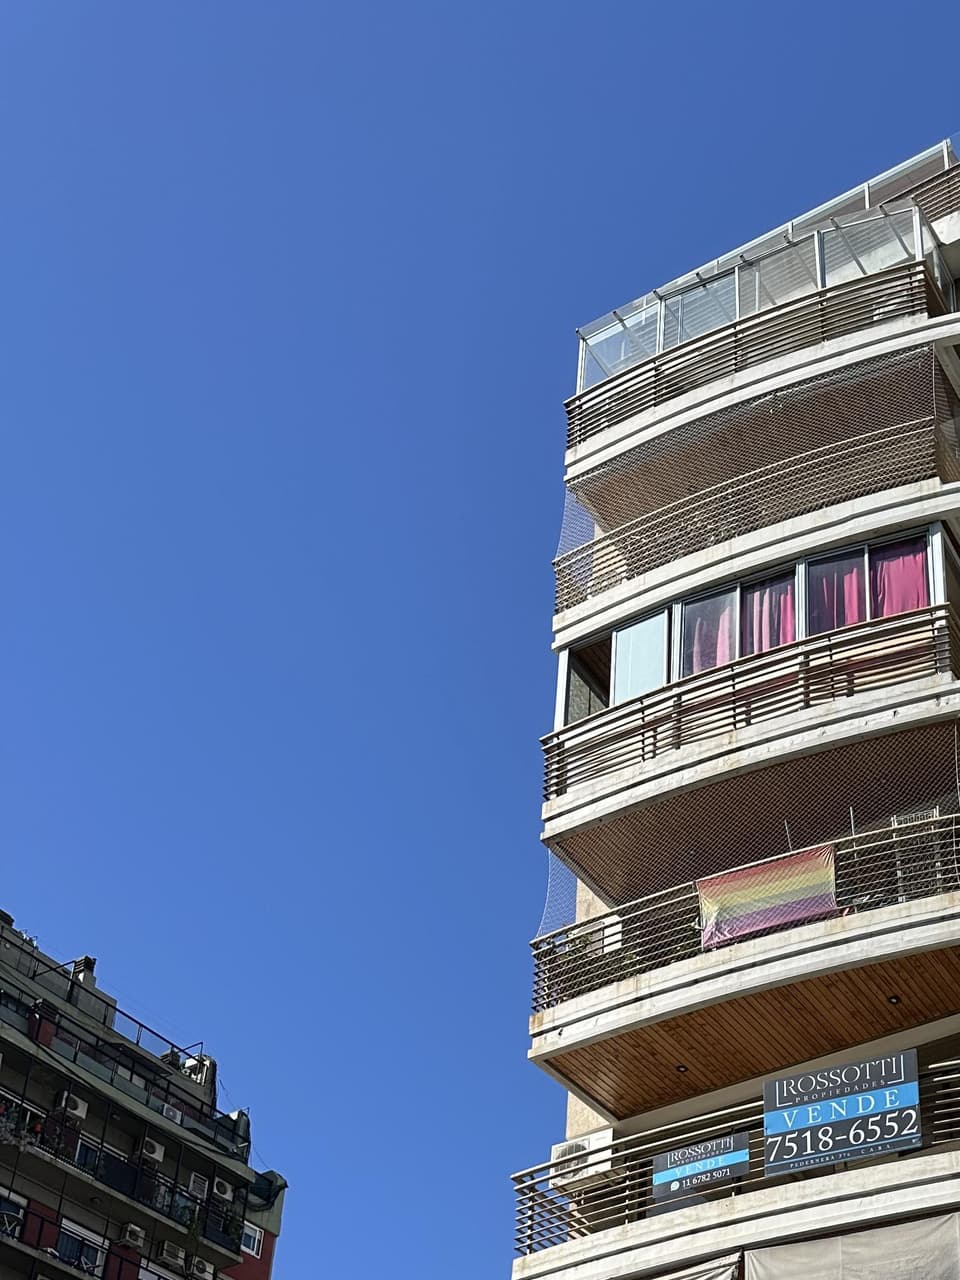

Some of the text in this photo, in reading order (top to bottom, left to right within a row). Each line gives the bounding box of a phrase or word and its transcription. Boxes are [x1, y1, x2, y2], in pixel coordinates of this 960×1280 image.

[783, 1057, 897, 1097] ROSSOTTI
[795, 1079, 886, 1104] PROPIEDADES
[782, 1089, 900, 1129] VENDE
[766, 1109, 919, 1162] 7518-6552
[671, 1137, 731, 1162] ROSSOTTI
[789, 1155, 836, 1168] PEDERNERA
[674, 1157, 726, 1177] VENDE
[682, 1179, 691, 1188] 11
[713, 1168, 731, 1179] 5071
